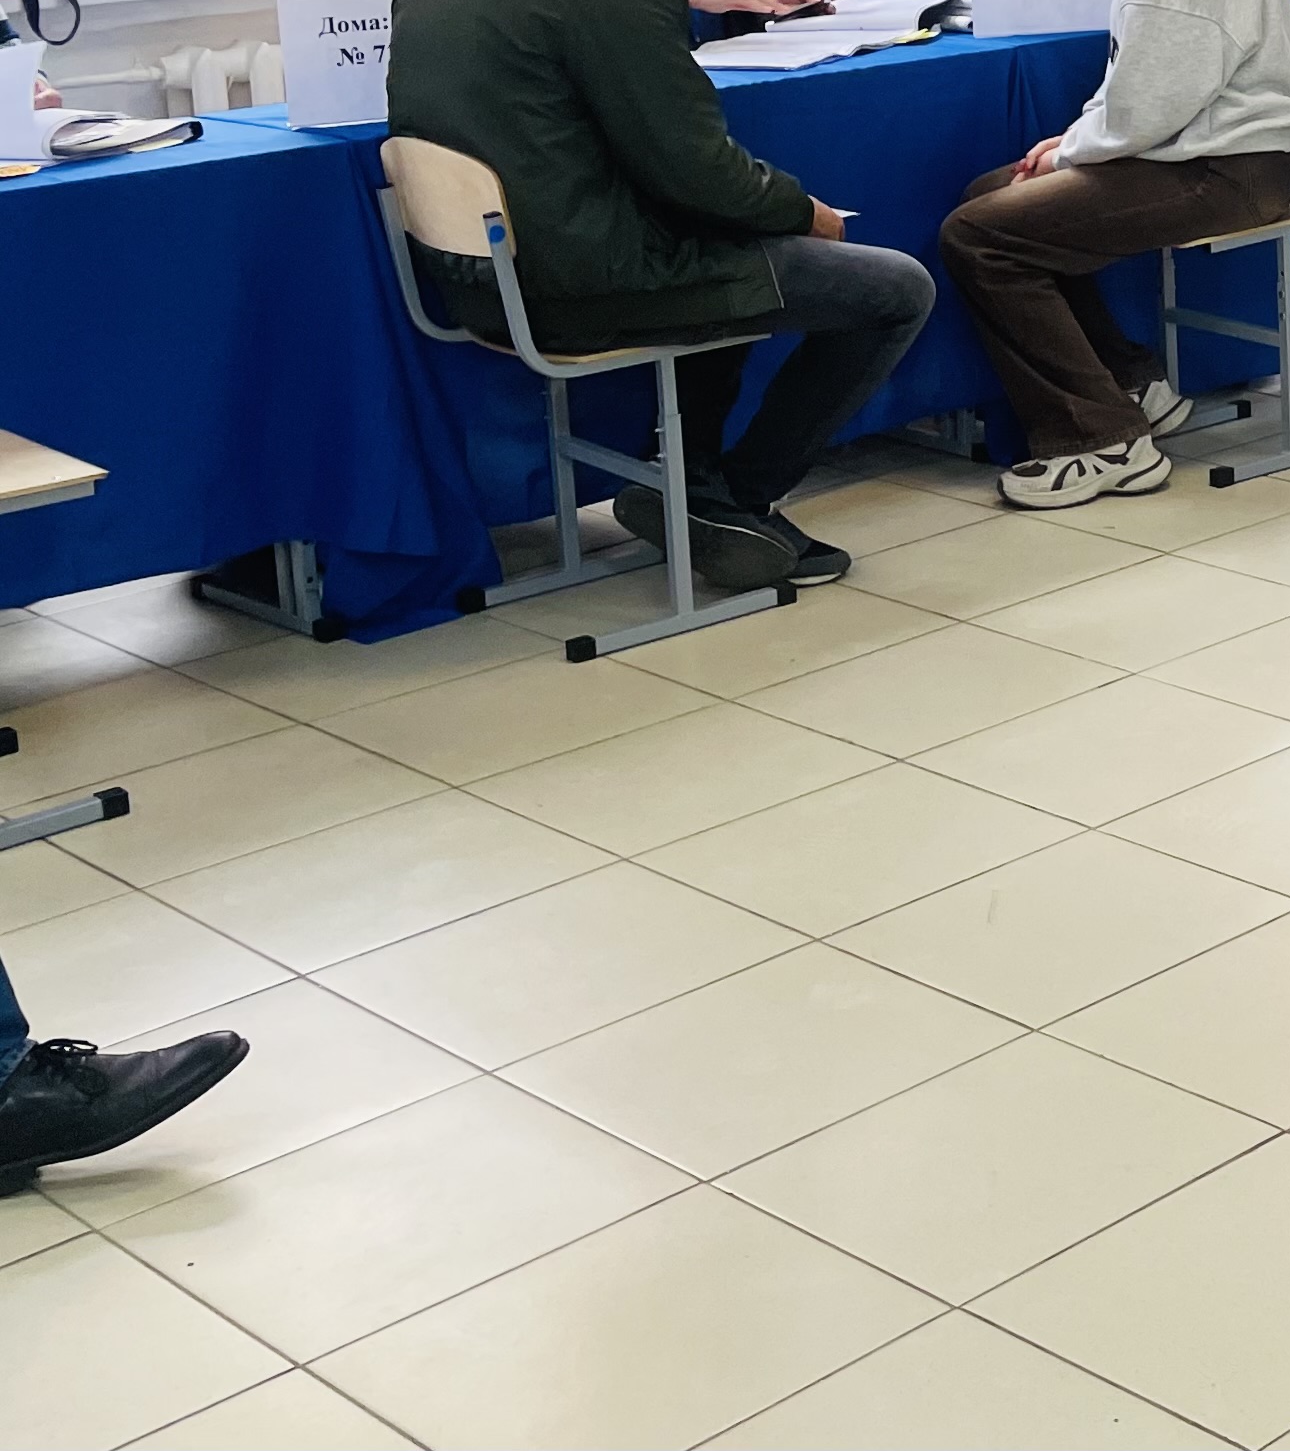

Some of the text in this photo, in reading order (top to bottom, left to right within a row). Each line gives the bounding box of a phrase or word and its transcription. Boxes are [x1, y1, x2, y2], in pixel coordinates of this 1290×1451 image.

[318, 16, 389, 39] Дома:
[336, 43, 390, 67] № 7
